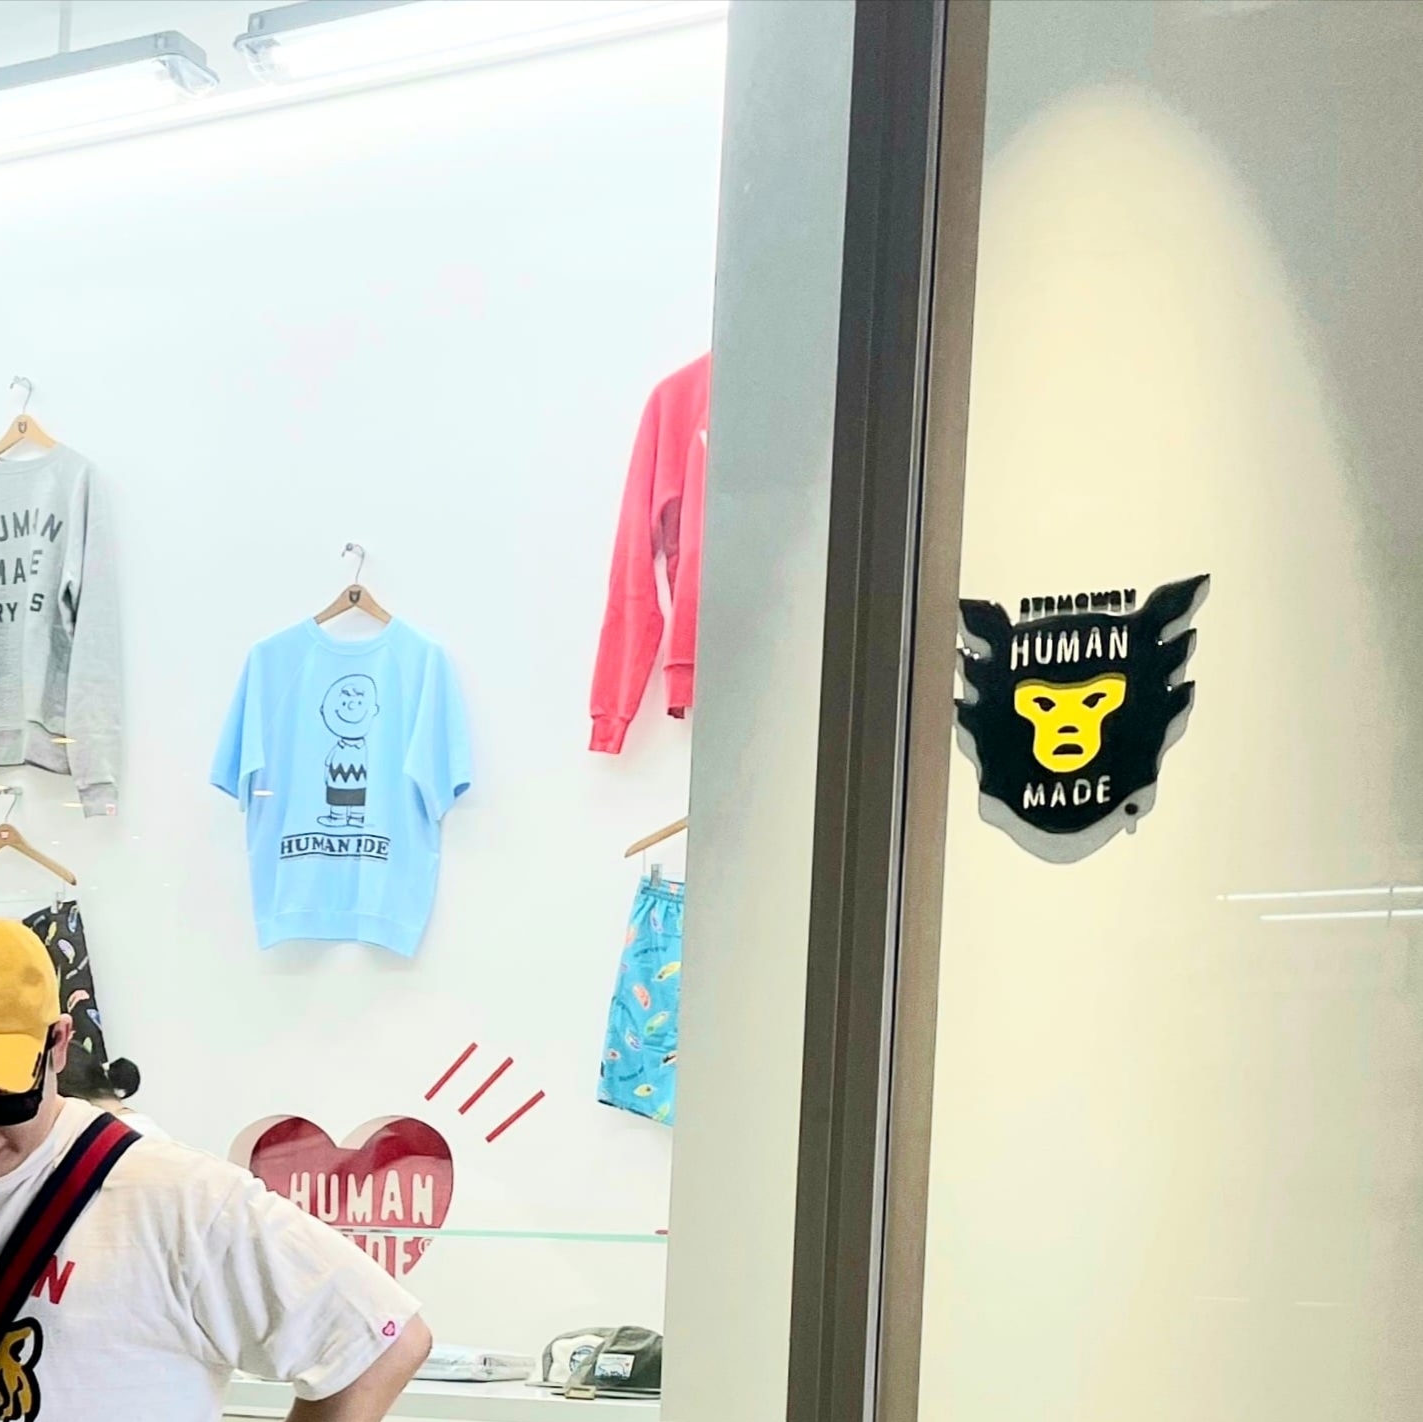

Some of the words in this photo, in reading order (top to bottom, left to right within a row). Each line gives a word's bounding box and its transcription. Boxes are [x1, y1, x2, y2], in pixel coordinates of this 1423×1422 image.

[1010, 624, 1128, 671] HUMAN
[1023, 775, 1111, 810] MADE
[281, 837, 349, 854] HUMAN
[290, 1170, 434, 1225] HUMAN
